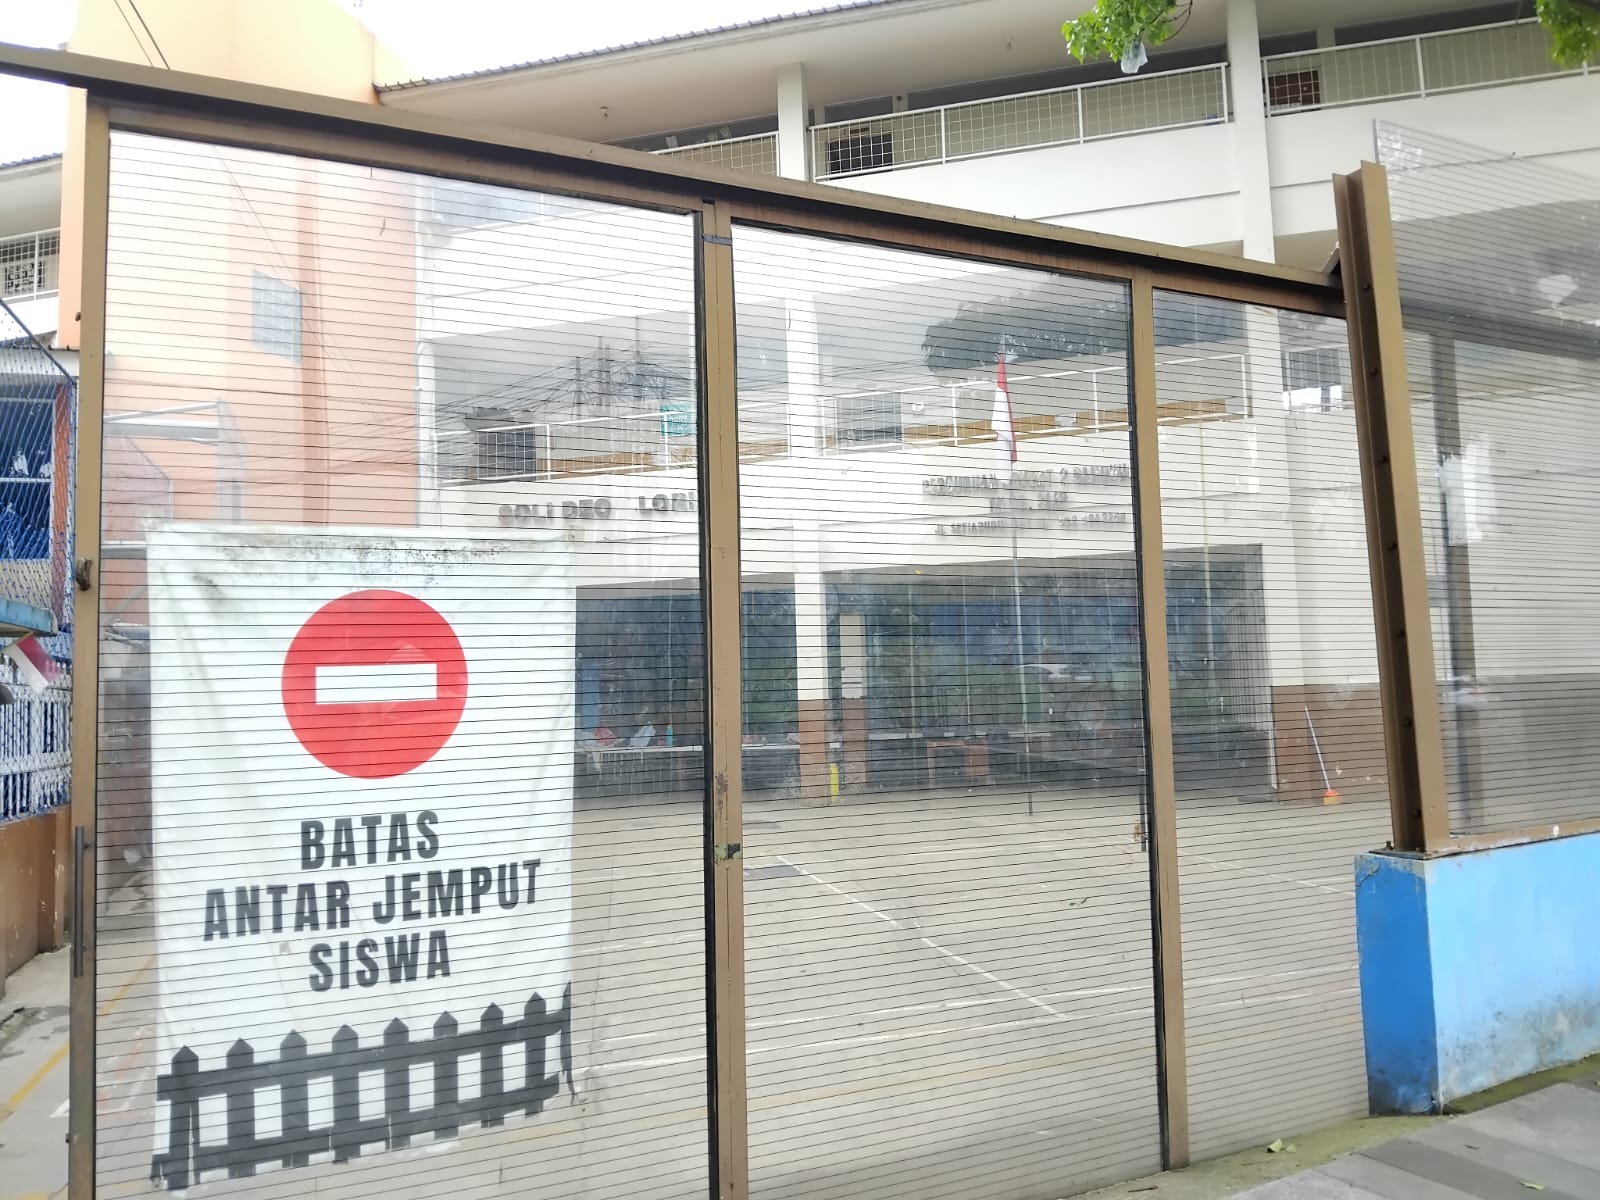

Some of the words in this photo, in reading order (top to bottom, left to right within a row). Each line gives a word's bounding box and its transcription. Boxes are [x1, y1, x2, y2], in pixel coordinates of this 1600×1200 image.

[562, 498, 612, 520] DEO
[639, 491, 695, 515] LORI
[301, 810, 439, 870] BATAS
[203, 880, 351, 942] ANTAR
[373, 858, 541, 925] JEMPUT
[309, 930, 451, 992] SISWA
